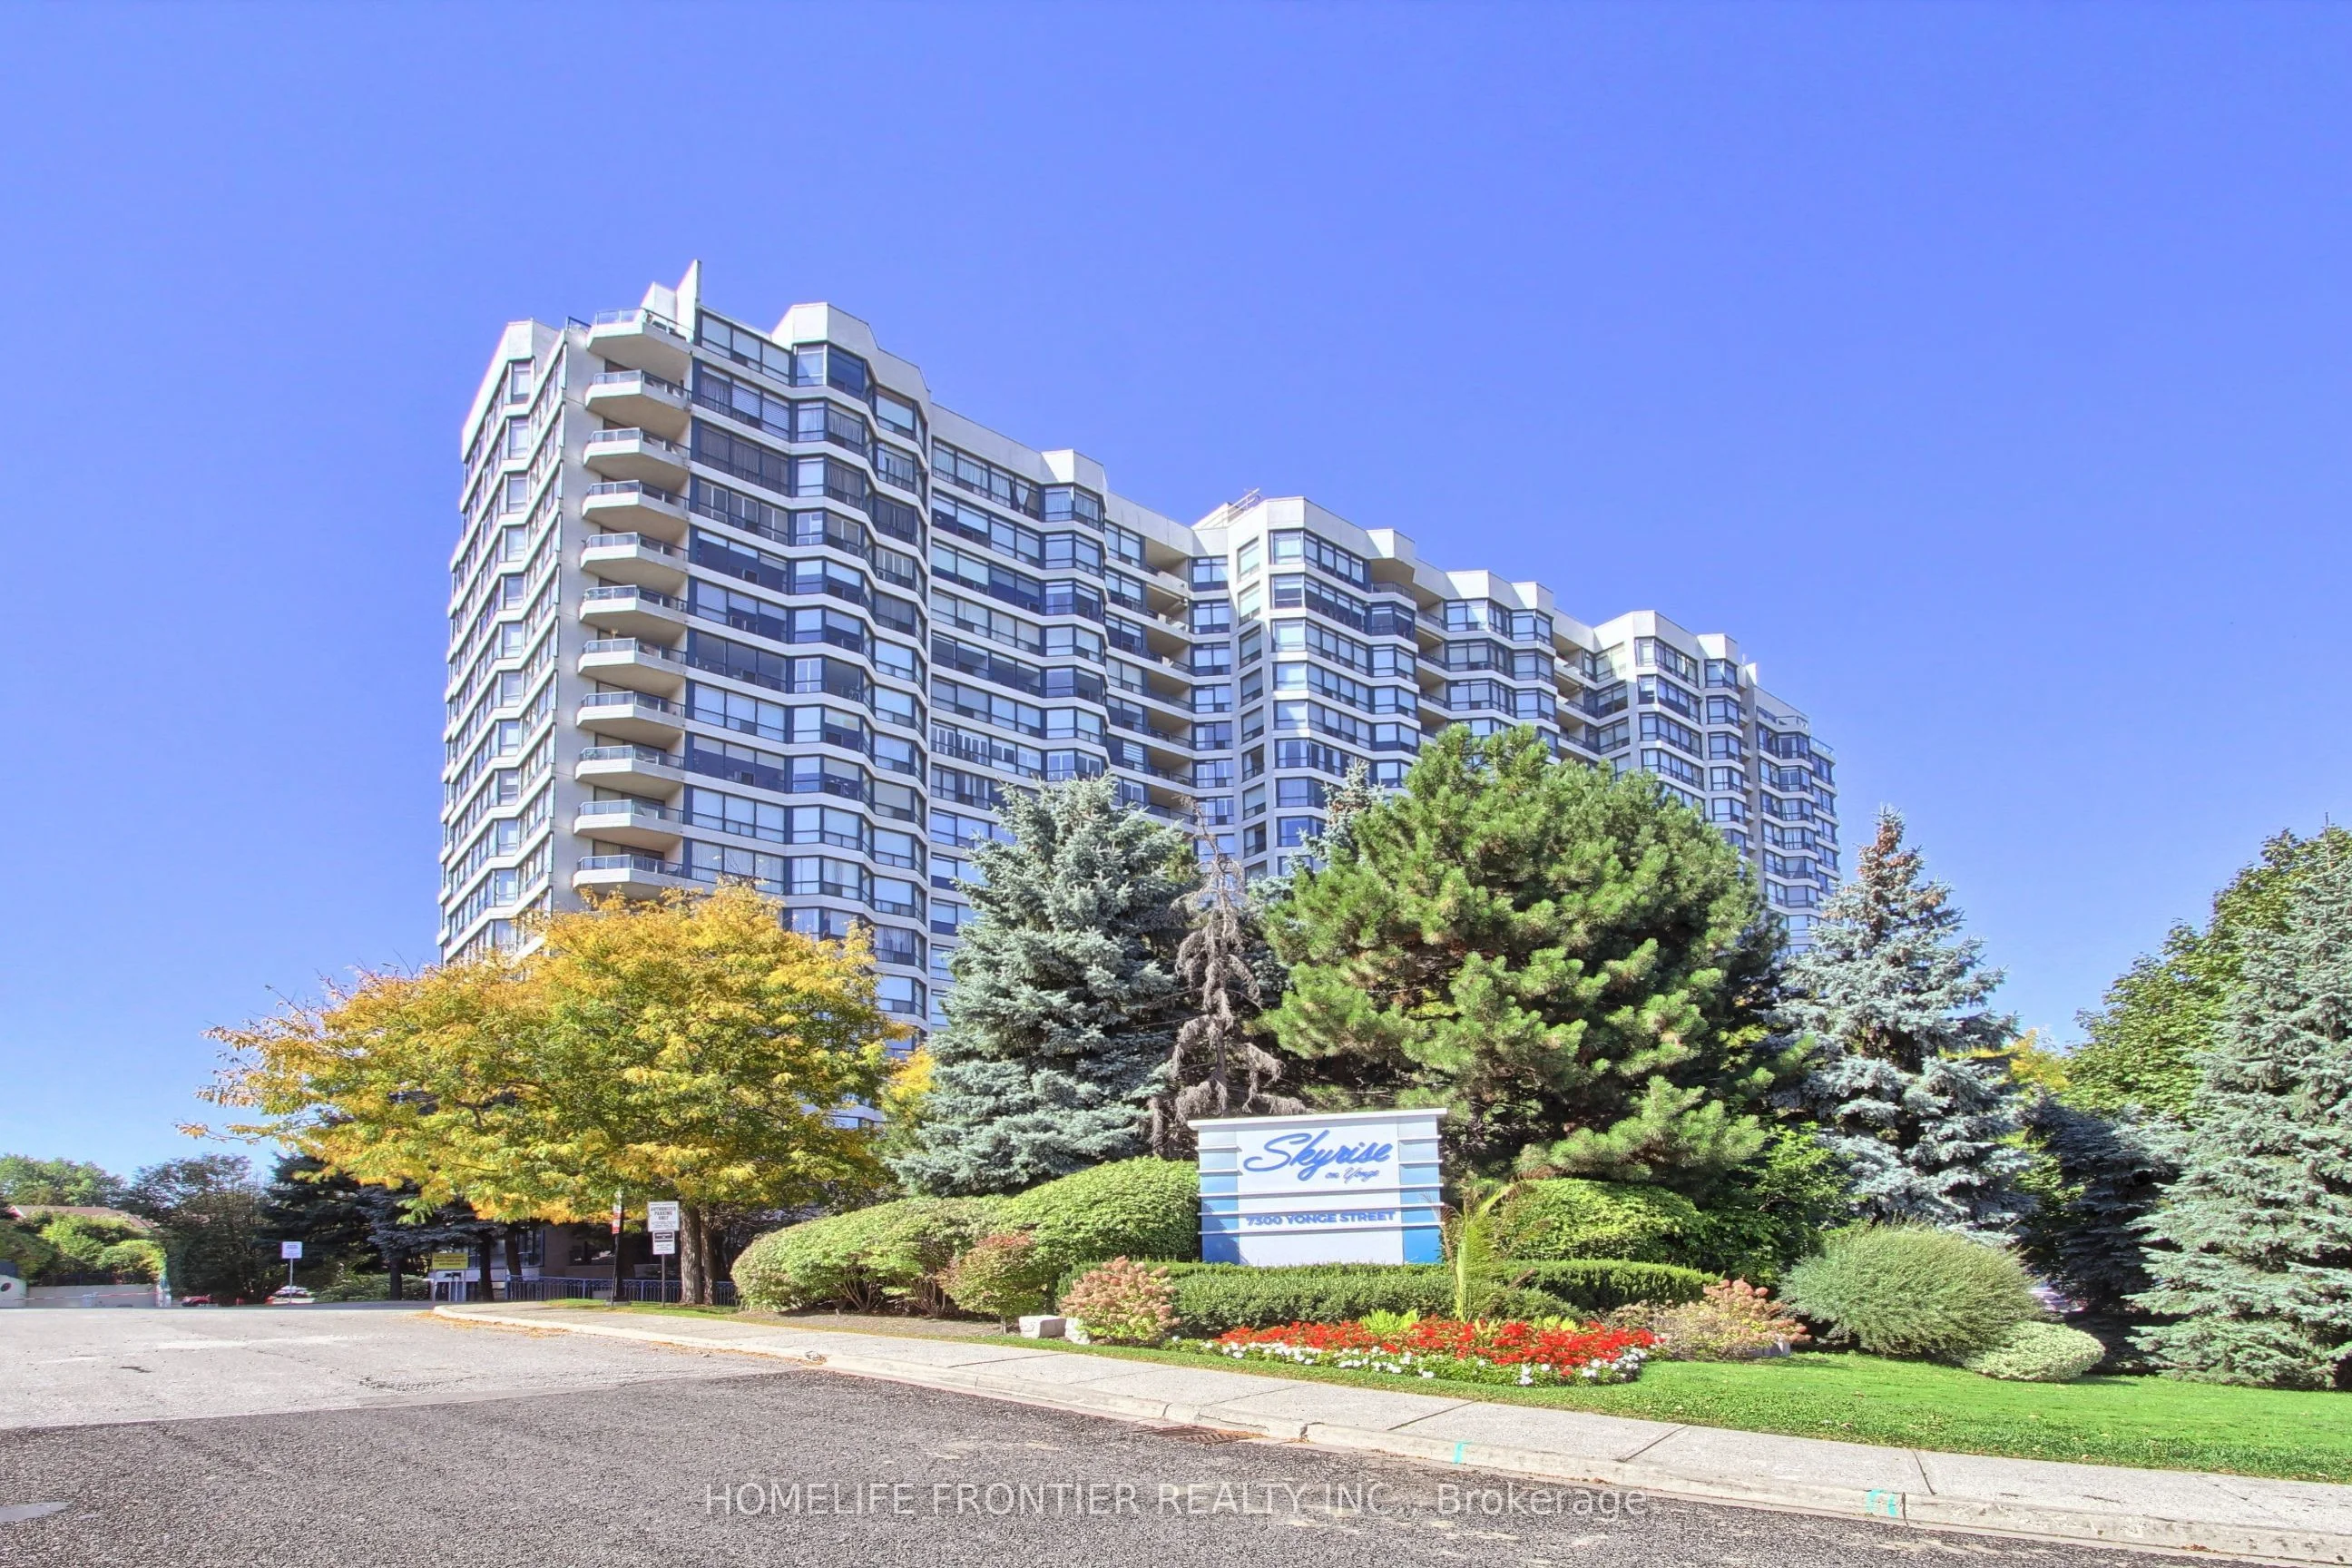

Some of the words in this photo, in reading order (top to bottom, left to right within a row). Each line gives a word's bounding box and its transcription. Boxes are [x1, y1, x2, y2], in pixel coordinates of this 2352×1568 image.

[1242, 1129, 1394, 1181] Skyrise
[1285, 1212, 1338, 1225] YONGE
[1339, 1210, 1396, 1222] STREET
